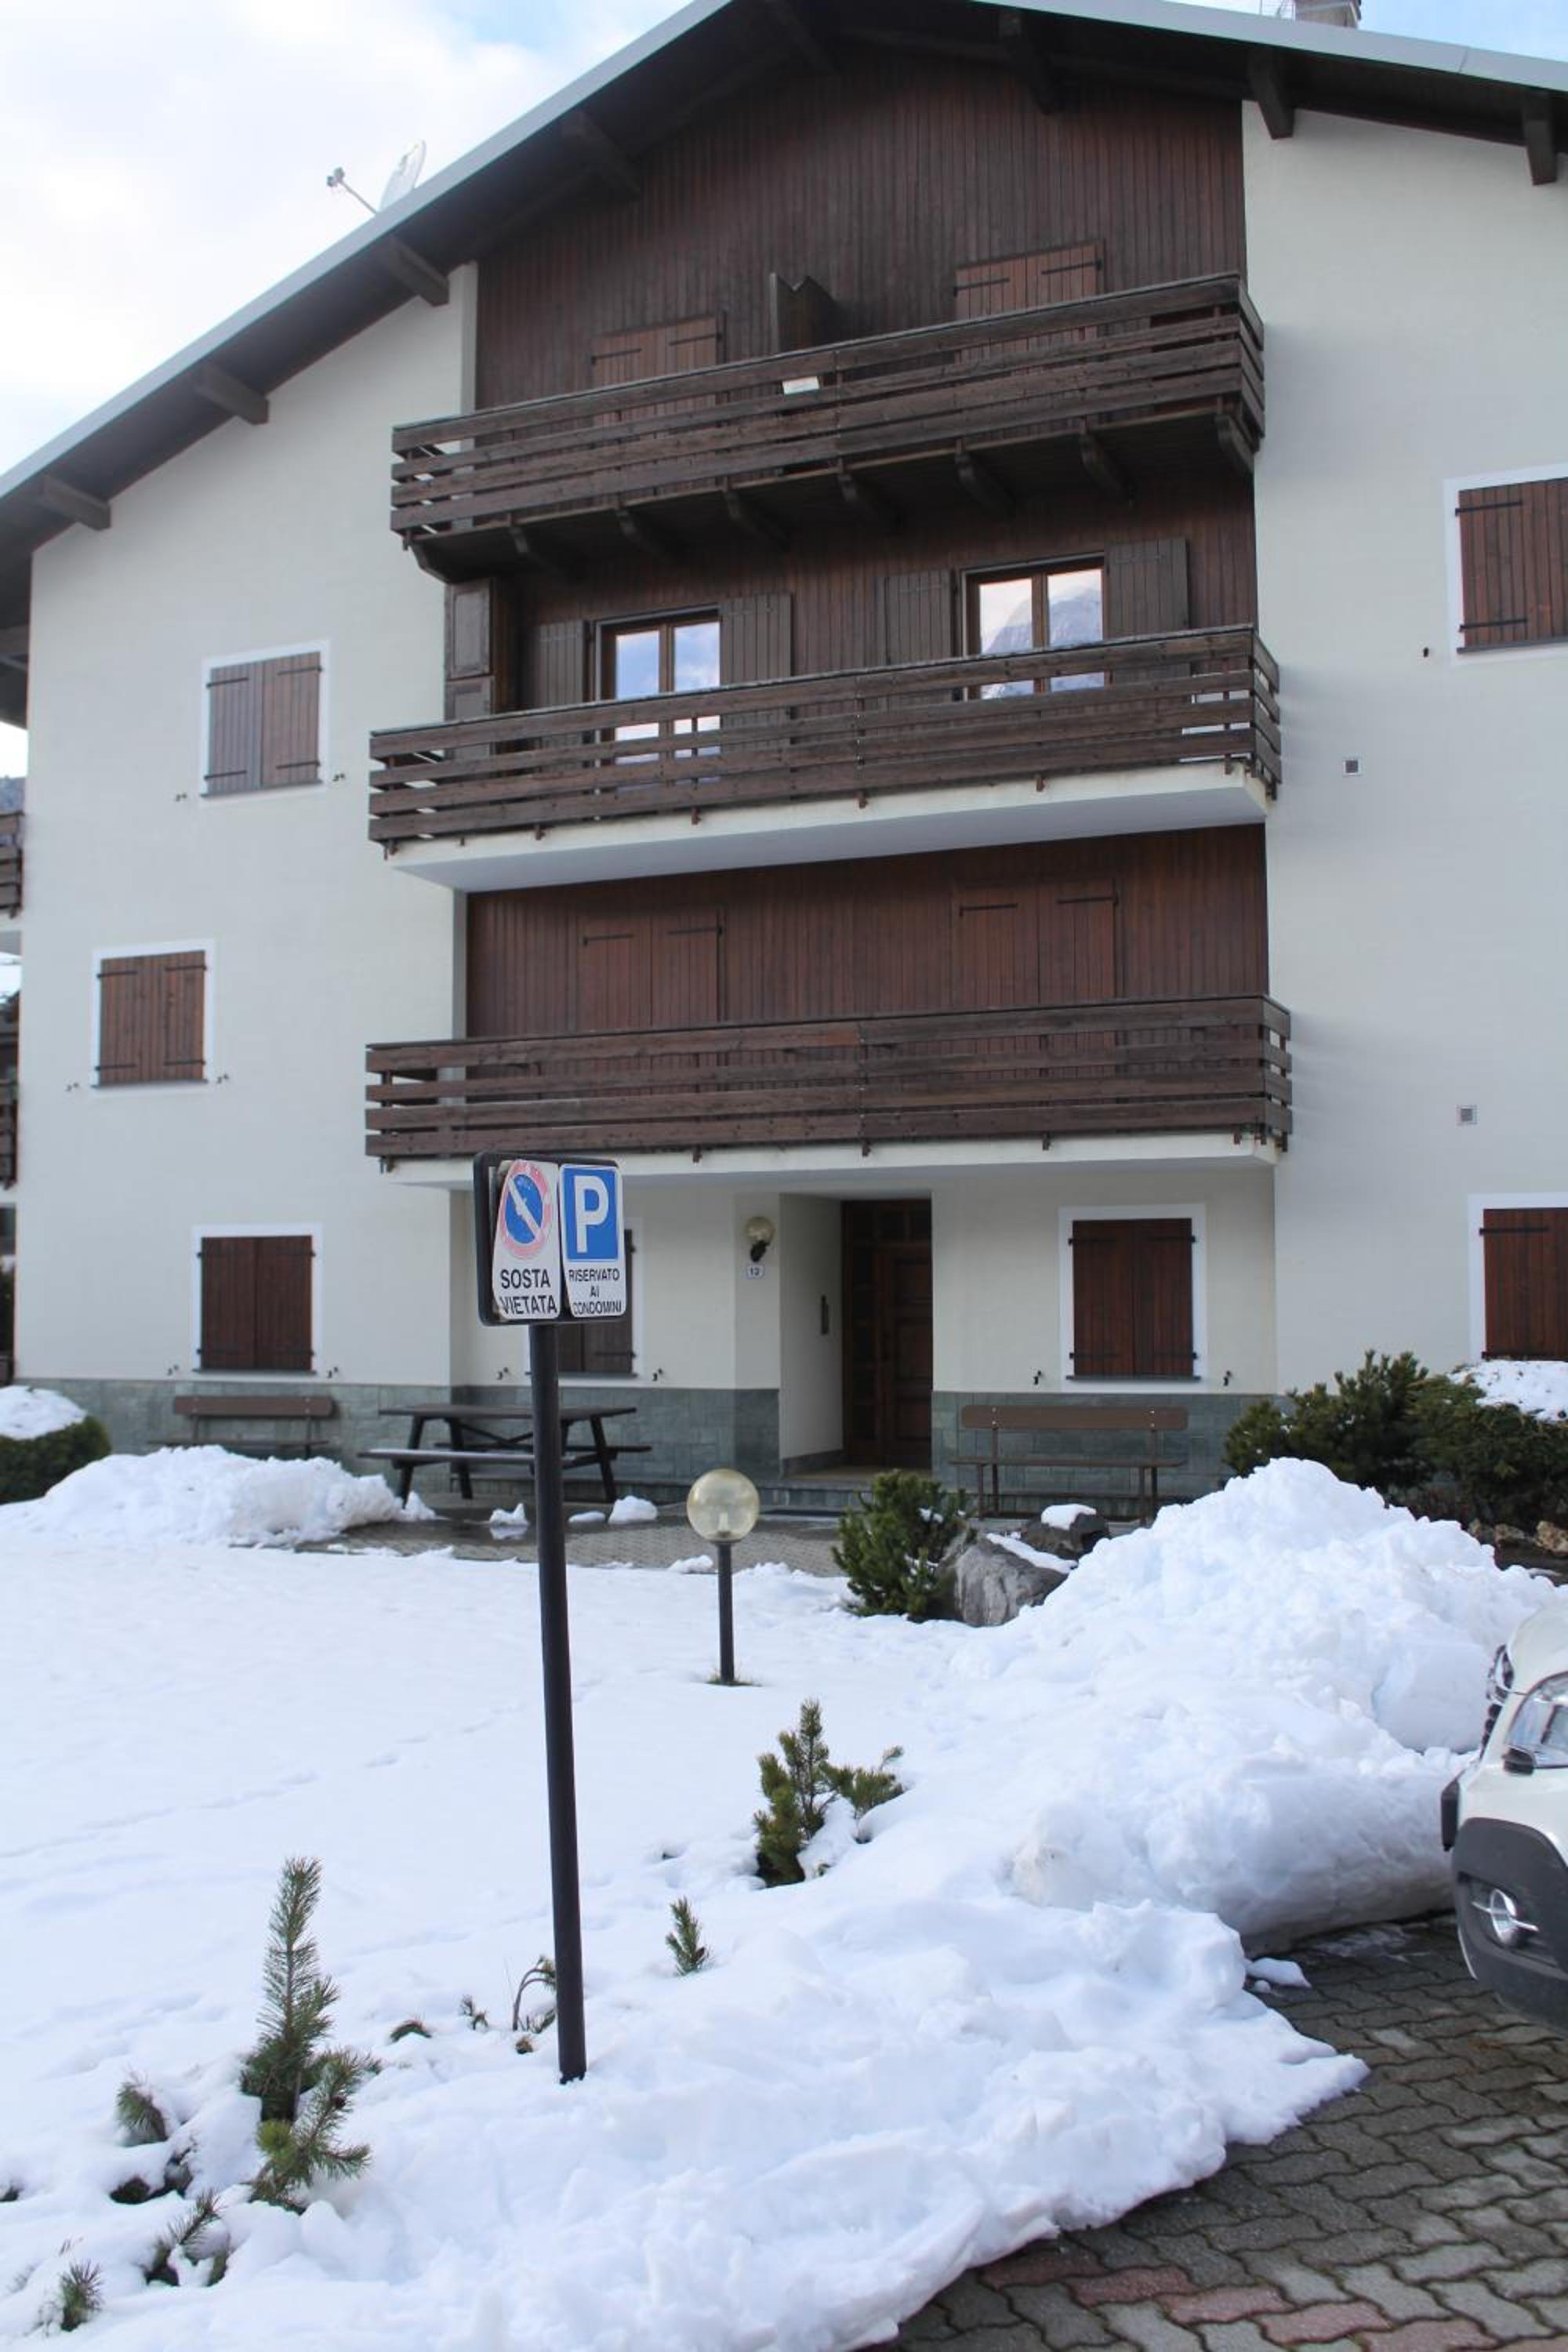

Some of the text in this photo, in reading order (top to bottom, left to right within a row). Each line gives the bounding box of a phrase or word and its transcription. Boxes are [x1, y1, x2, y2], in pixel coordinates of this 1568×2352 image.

[574, 1175, 609, 1254] P
[500, 1269, 551, 1289] SOSTA
[568, 1269, 620, 1281] RISERVATO
[590, 1285, 600, 1298] AI
[499, 1295, 557, 1315] VIETATA
[572, 1301, 622, 1316] CONDOMINI
